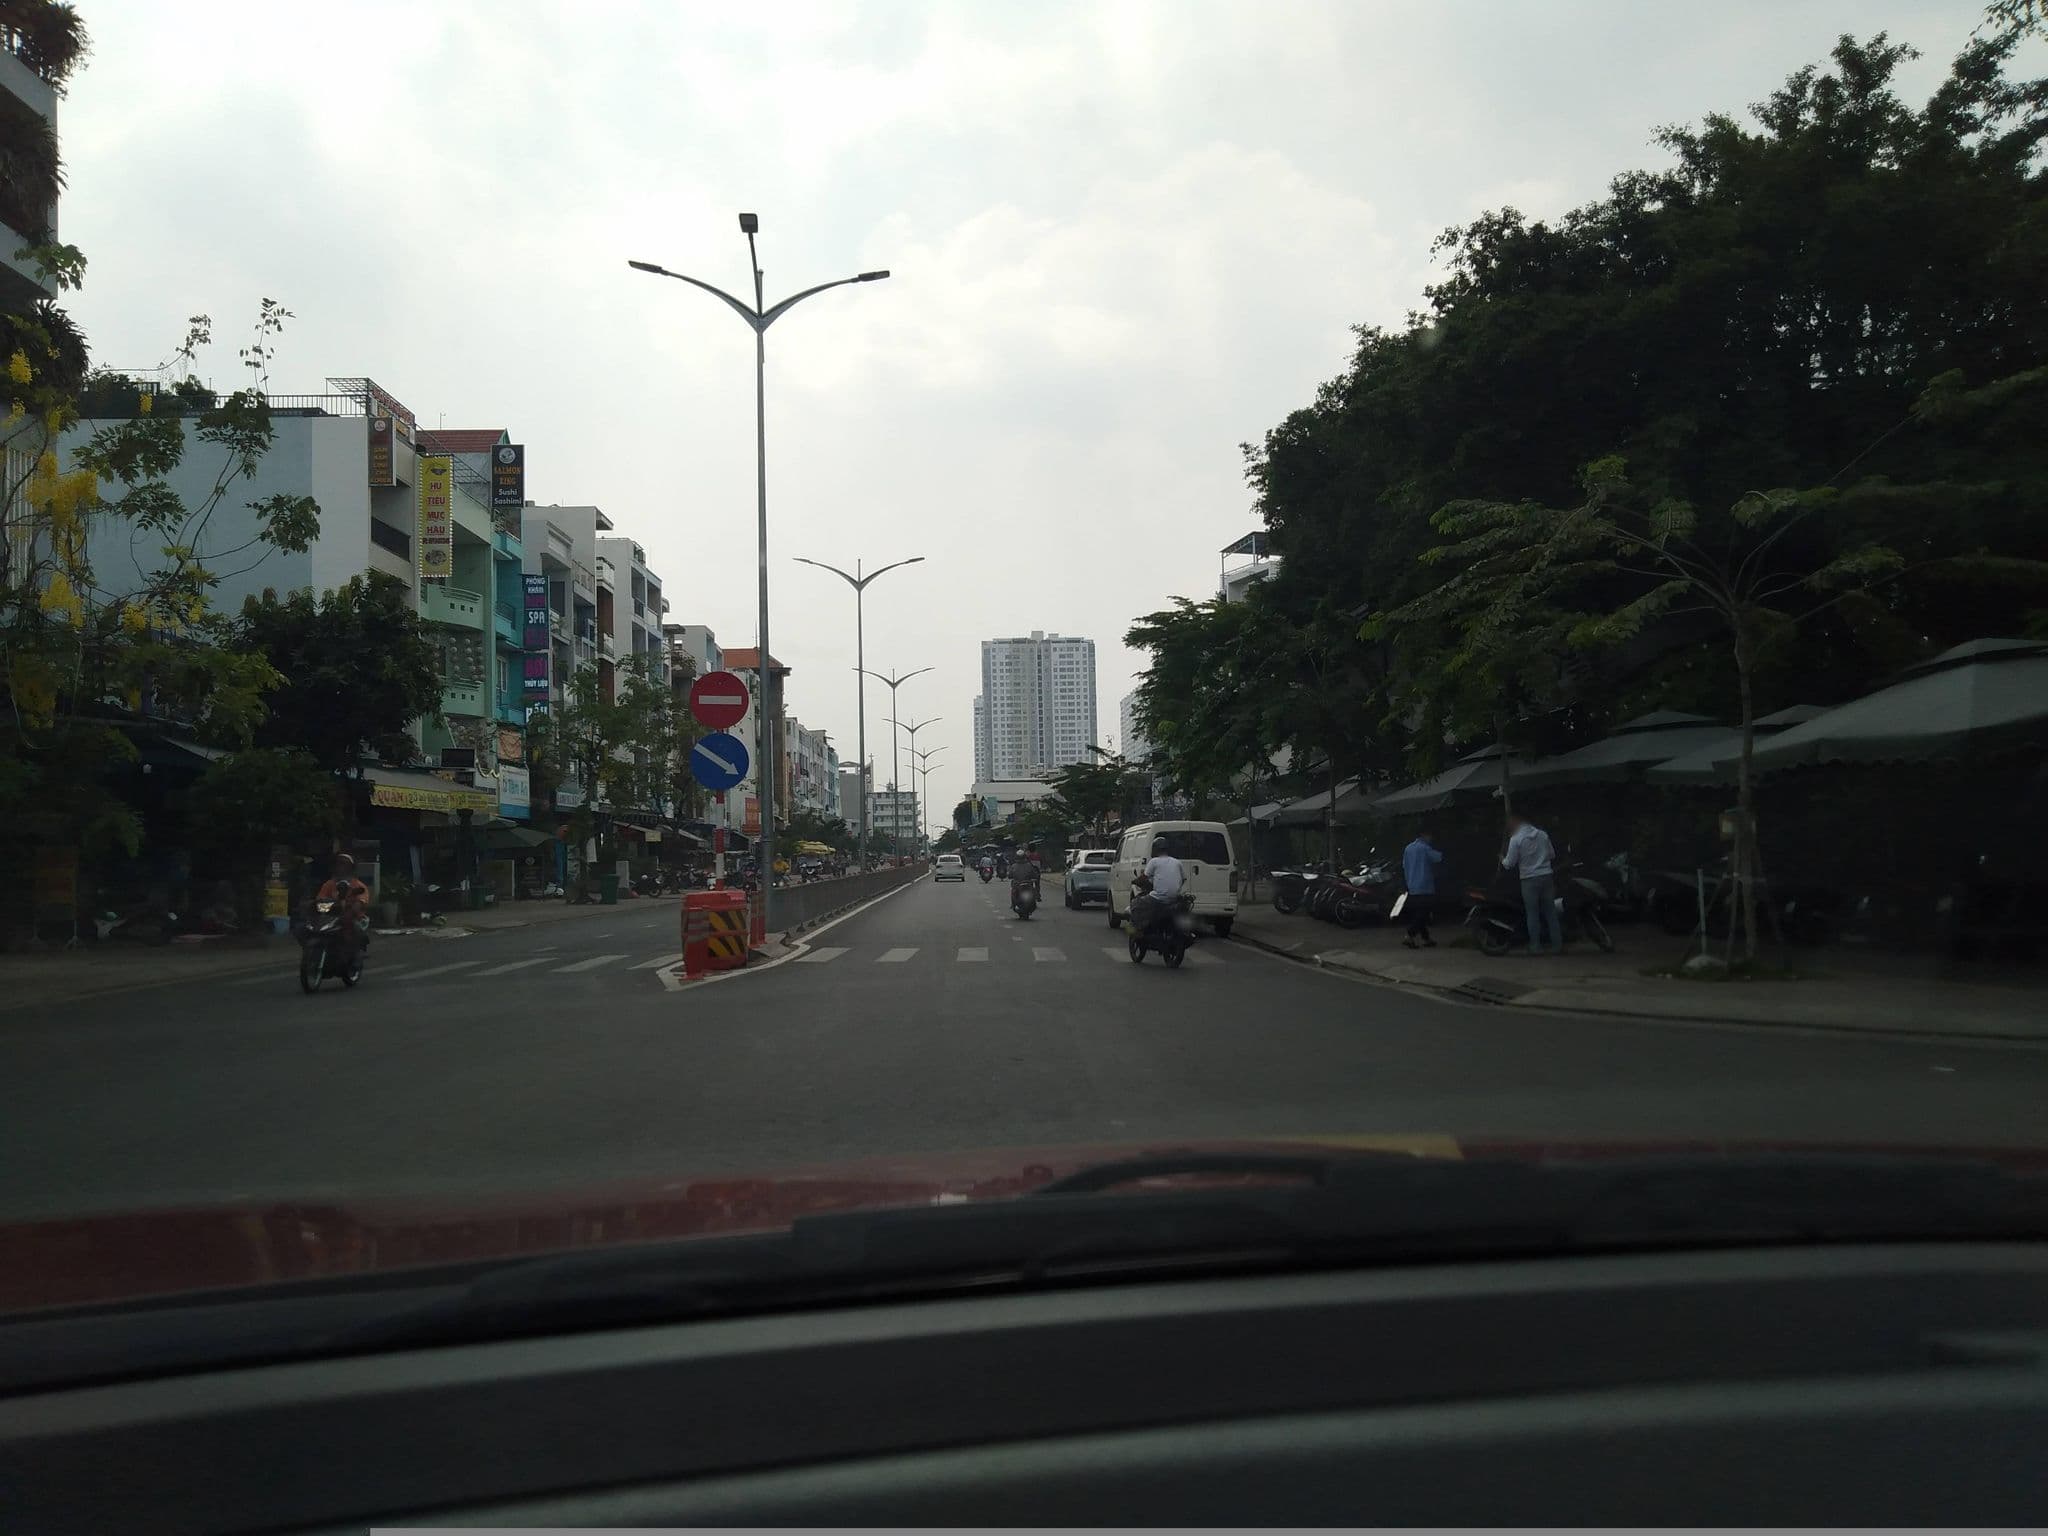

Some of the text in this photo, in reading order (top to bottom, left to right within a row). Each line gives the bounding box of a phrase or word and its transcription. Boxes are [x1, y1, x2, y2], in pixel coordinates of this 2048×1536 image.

[498, 488, 517, 496] Sushi
[494, 497, 522, 505] Sashimi
[528, 611, 545, 624] SPA
